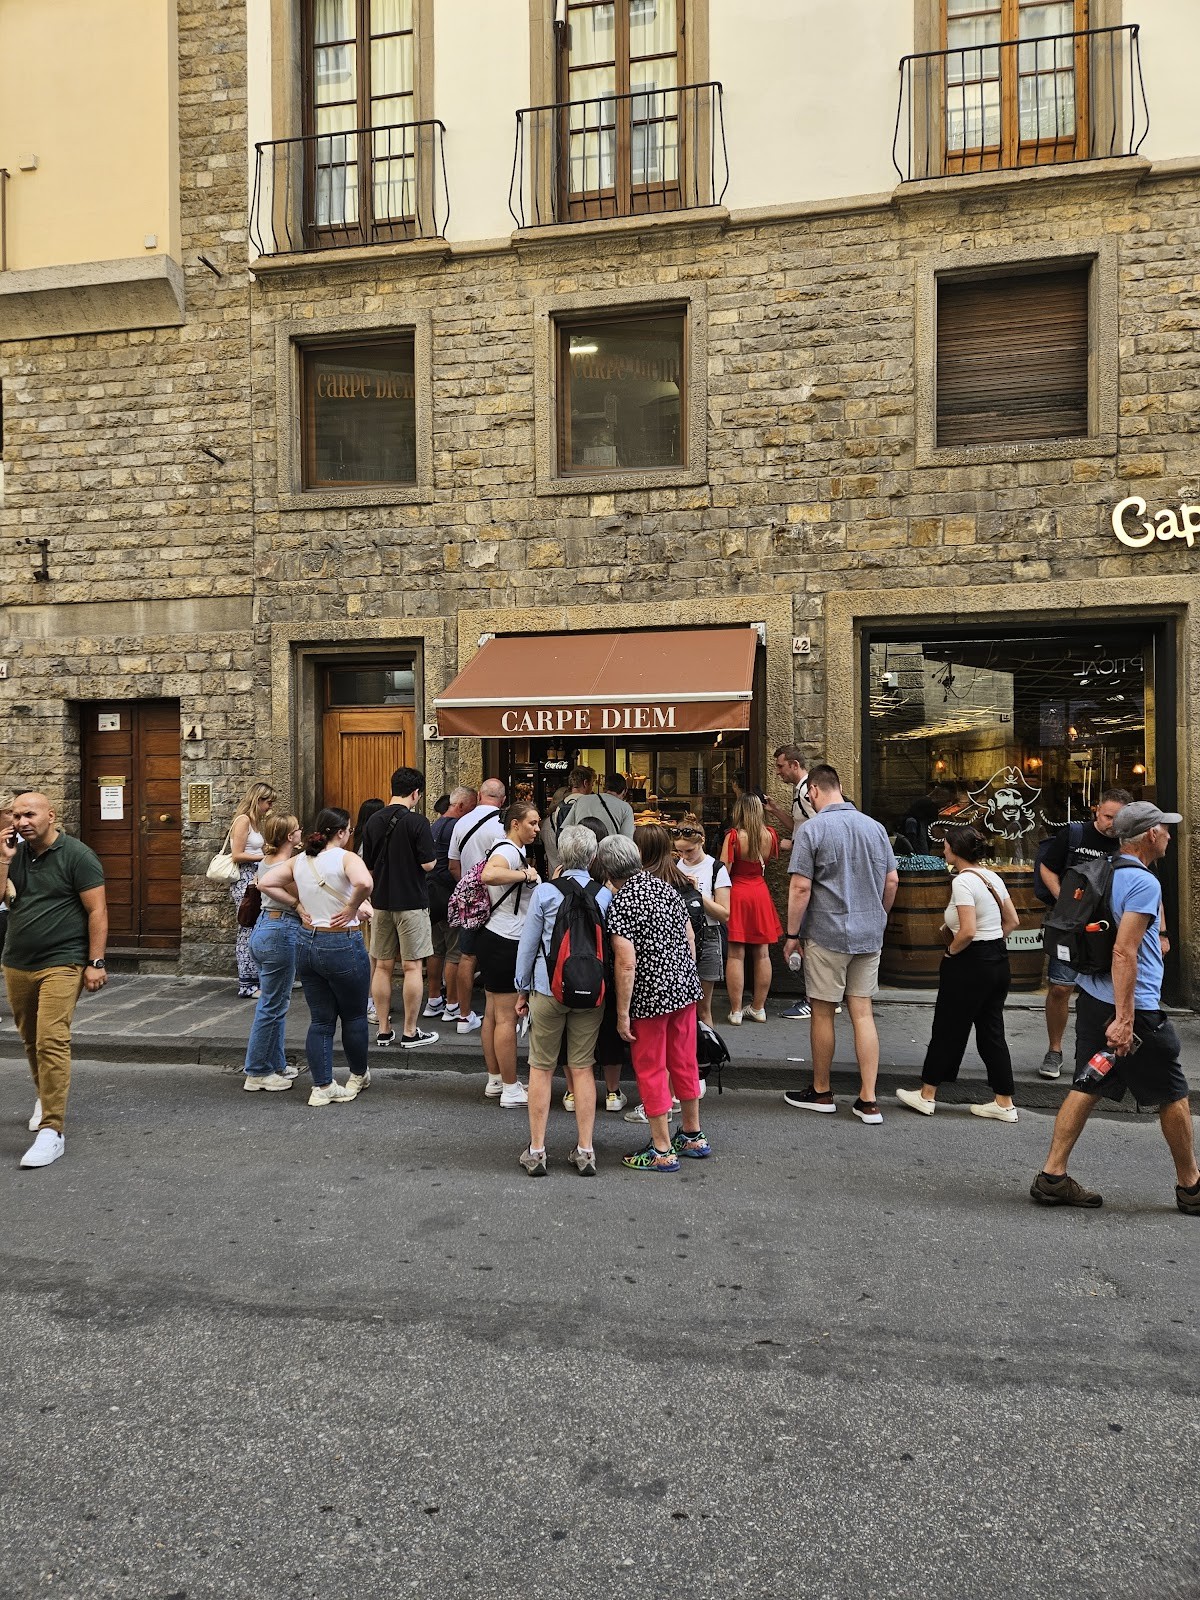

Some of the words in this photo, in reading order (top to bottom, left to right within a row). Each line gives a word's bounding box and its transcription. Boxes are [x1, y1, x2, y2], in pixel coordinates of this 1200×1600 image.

[1112, 496, 1200, 548] Cap
[794, 640, 809, 651] 42
[501, 709, 591, 732] CARPE
[600, 706, 676, 730] DIEM
[188, 726, 197, 738] 4
[429, 725, 438, 739] 2
